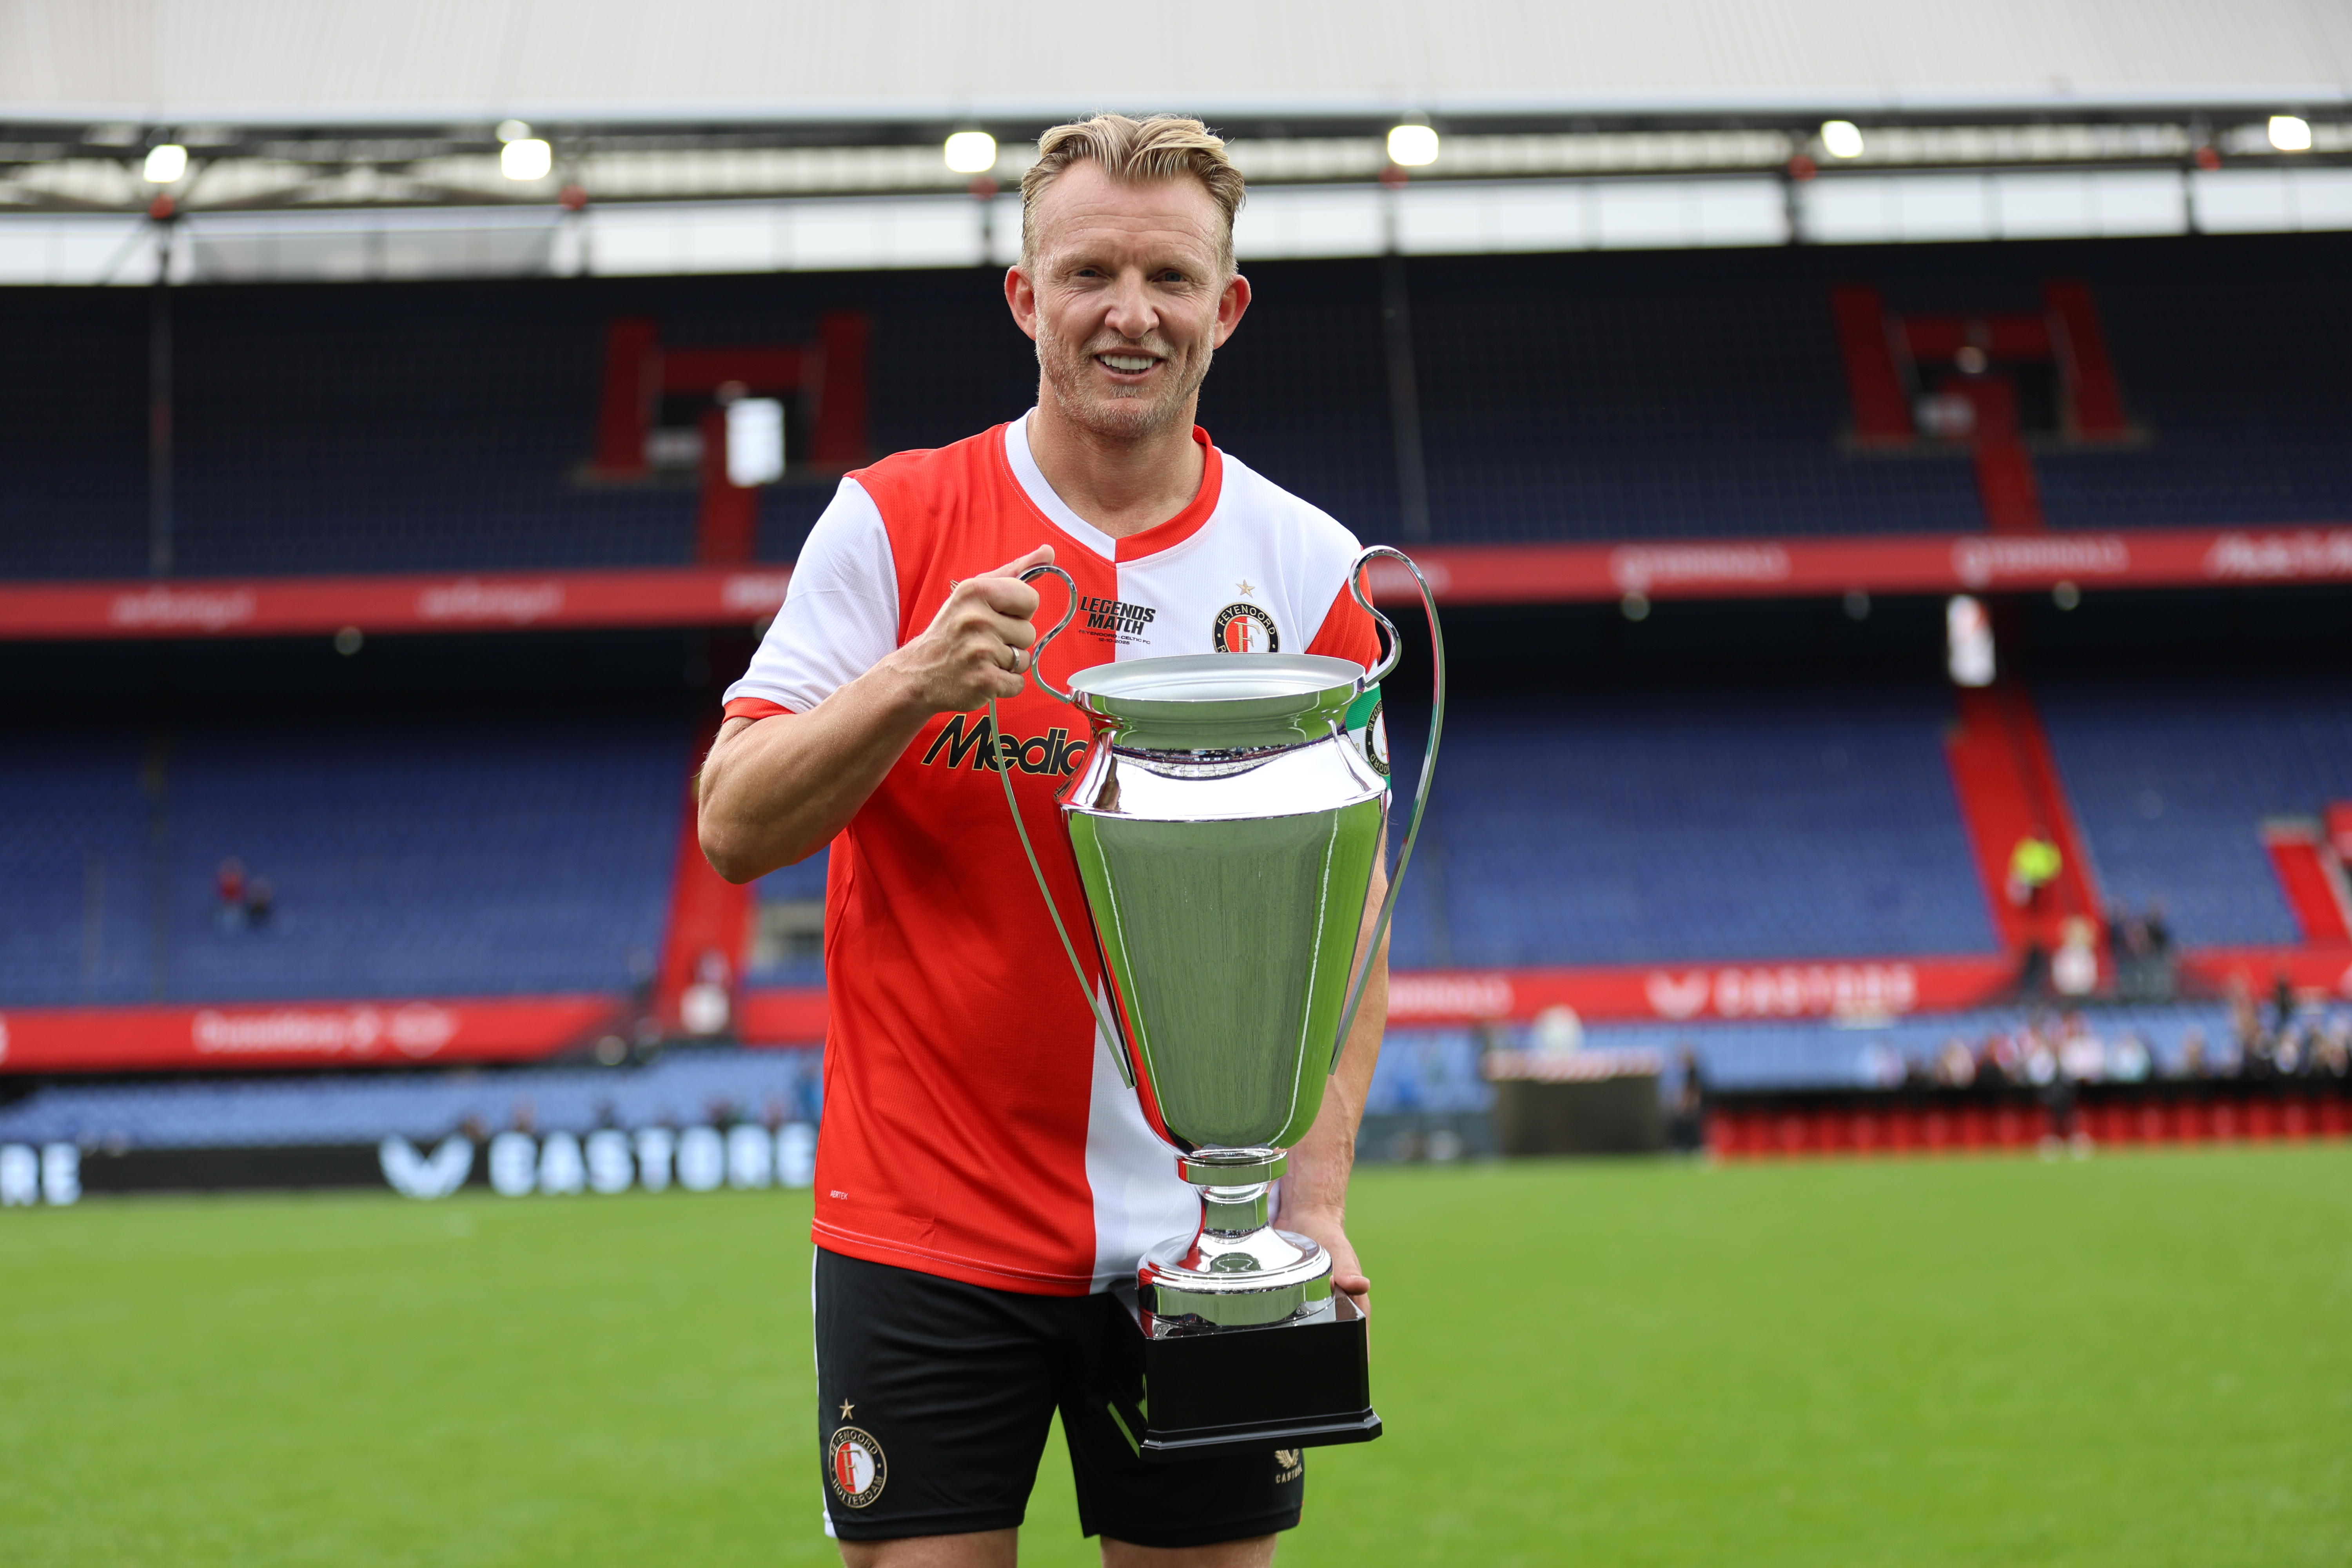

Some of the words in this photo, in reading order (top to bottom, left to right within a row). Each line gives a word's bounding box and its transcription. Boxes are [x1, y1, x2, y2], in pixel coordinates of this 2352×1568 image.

[1079, 596, 1156, 623] LEGENDS
[1217, 605, 1276, 635] FEYENOORD
[1079, 629, 1117, 638] FEYENOORD
[1086, 612, 1145, 635] MATCH
[830, 1190, 848, 1200] AERTEK
[831, 1430, 878, 1457] FEYENOORD
[833, 1475, 884, 1506] ROTTERDAM
